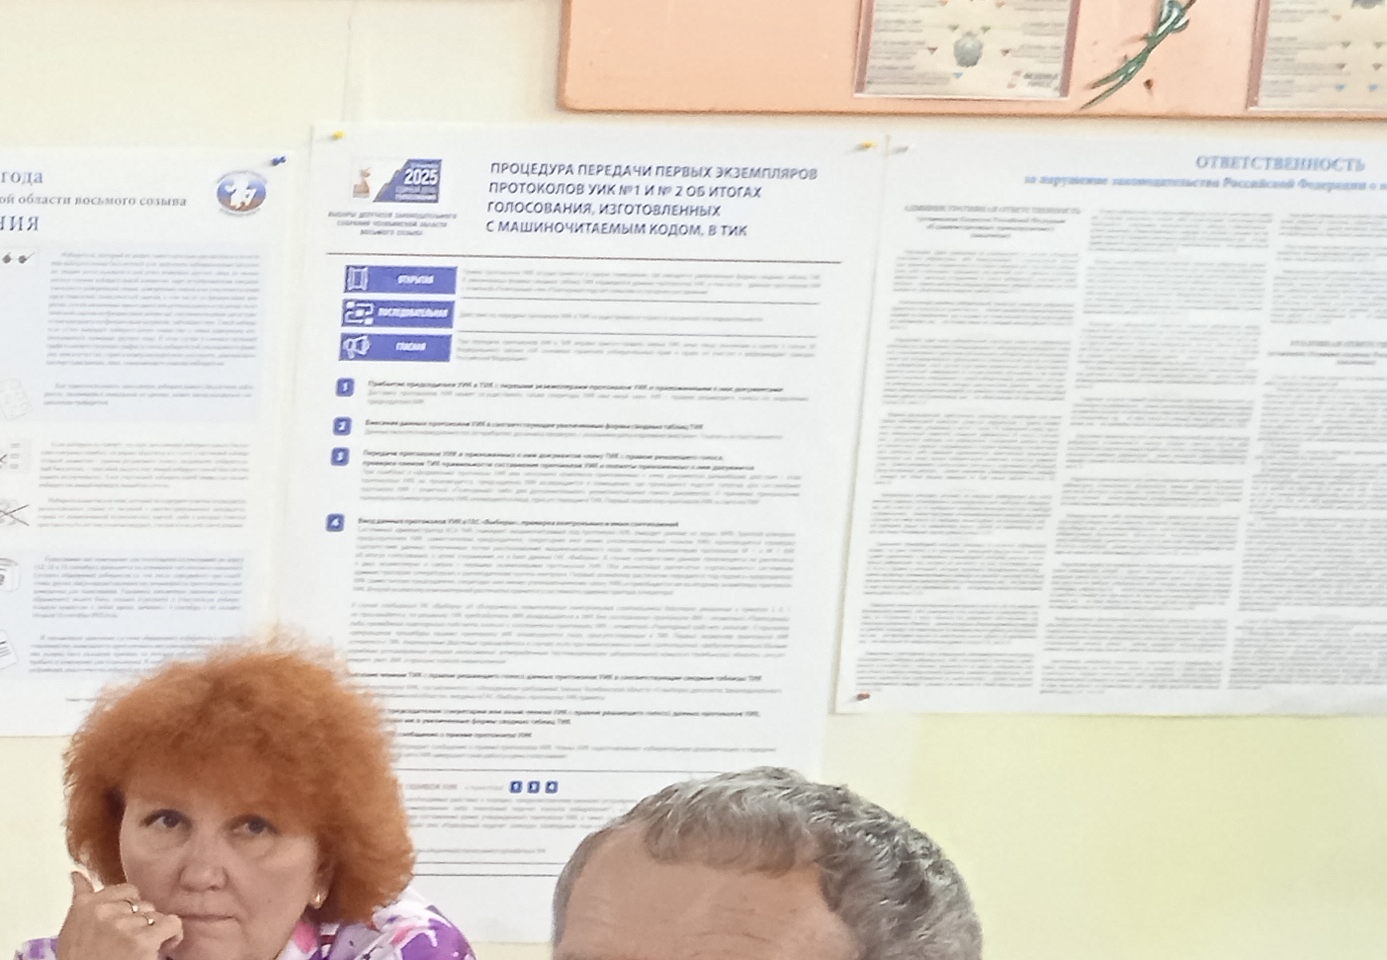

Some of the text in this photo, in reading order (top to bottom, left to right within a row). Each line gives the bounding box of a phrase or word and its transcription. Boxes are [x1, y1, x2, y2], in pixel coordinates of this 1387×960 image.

[490, 162, 818, 181] ПРОЦЕДУРА ПЕРЕДАЧИ ПЕРВЫХ ЭКЗЕМПЛЯРОВ
[1196, 155, 1365, 172] ОТВЕТСТВЕННОСТЬ
[1, 171, 43, 186] года
[404, 169, 438, 185] 2025
[1223, 178, 1294, 190] Российской
[488, 182, 585, 196] ПРОТОКОЛОВ
[588, 183, 616, 197] УИК
[644, 185, 654, 196] И
[657, 185, 671, 197] №
[675, 186, 683, 197] 2
[686, 186, 705, 198] ОБ
[708, 186, 762, 199] ИТОГАХ
[18, 192, 71, 206] области
[75, 196, 136, 207] восьмого
[139, 197, 187, 207] созыва
[487, 202, 721, 218] ГОЛОСОВАНИЯ, ИЗГОТОВЛЕННЫХ
[486, 220, 747, 239] С МАШИНОЧИТАЕМЫМ КОДОМ, В ТИК
[332, 518, 340, 527] 4
